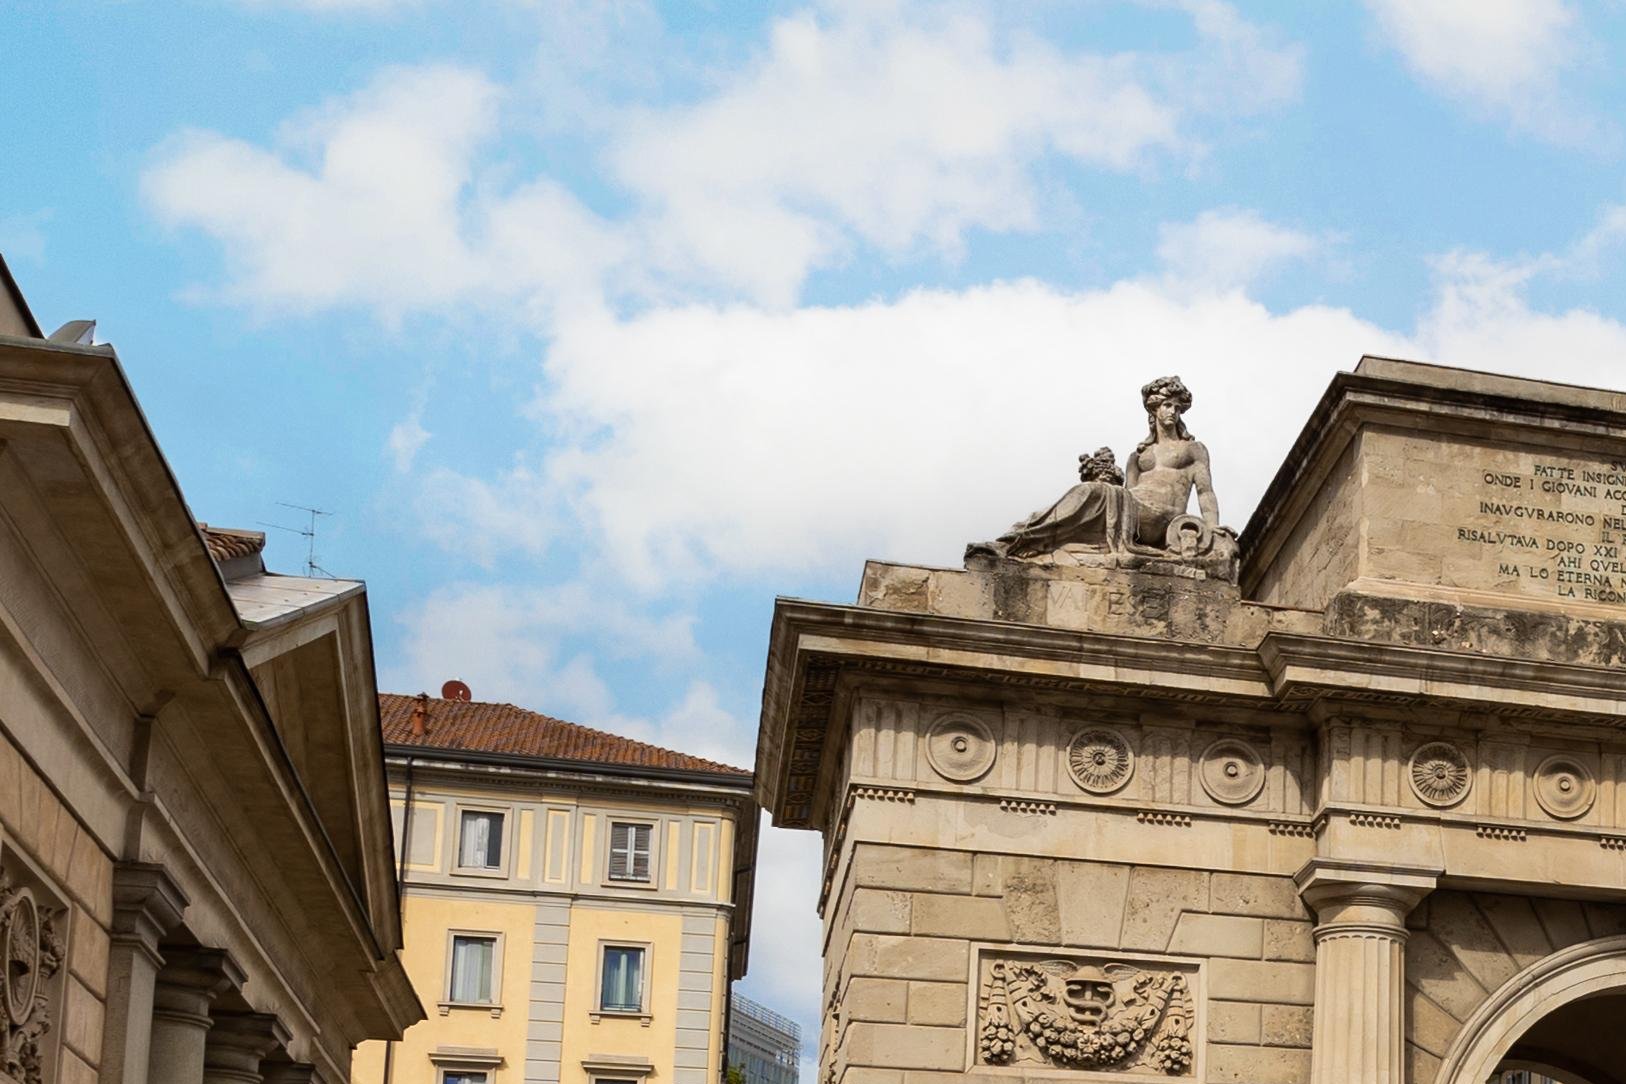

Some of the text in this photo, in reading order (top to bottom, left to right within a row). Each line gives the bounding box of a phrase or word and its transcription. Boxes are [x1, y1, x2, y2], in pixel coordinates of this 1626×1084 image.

[1534, 465, 1575, 480] FATTE
[1484, 473, 1521, 488] ONDE
[1530, 479, 1534, 490] I
[1542, 481, 1597, 498] GIOVANI
[1480, 502, 1595, 526] INAVGVRARONO
[1457, 528, 1539, 549] RISALVTAVA
[1547, 539, 1585, 554] DOPO
[1594, 545, 1618, 558] XXI
[1602, 532, 1614, 543] IL
[1558, 557, 1582, 569] AHI
[1499, 564, 1520, 577] MA
[1530, 567, 1549, 579] LO
[1557, 571, 1612, 588] ETERNA
[1558, 586, 1576, 598] LA
